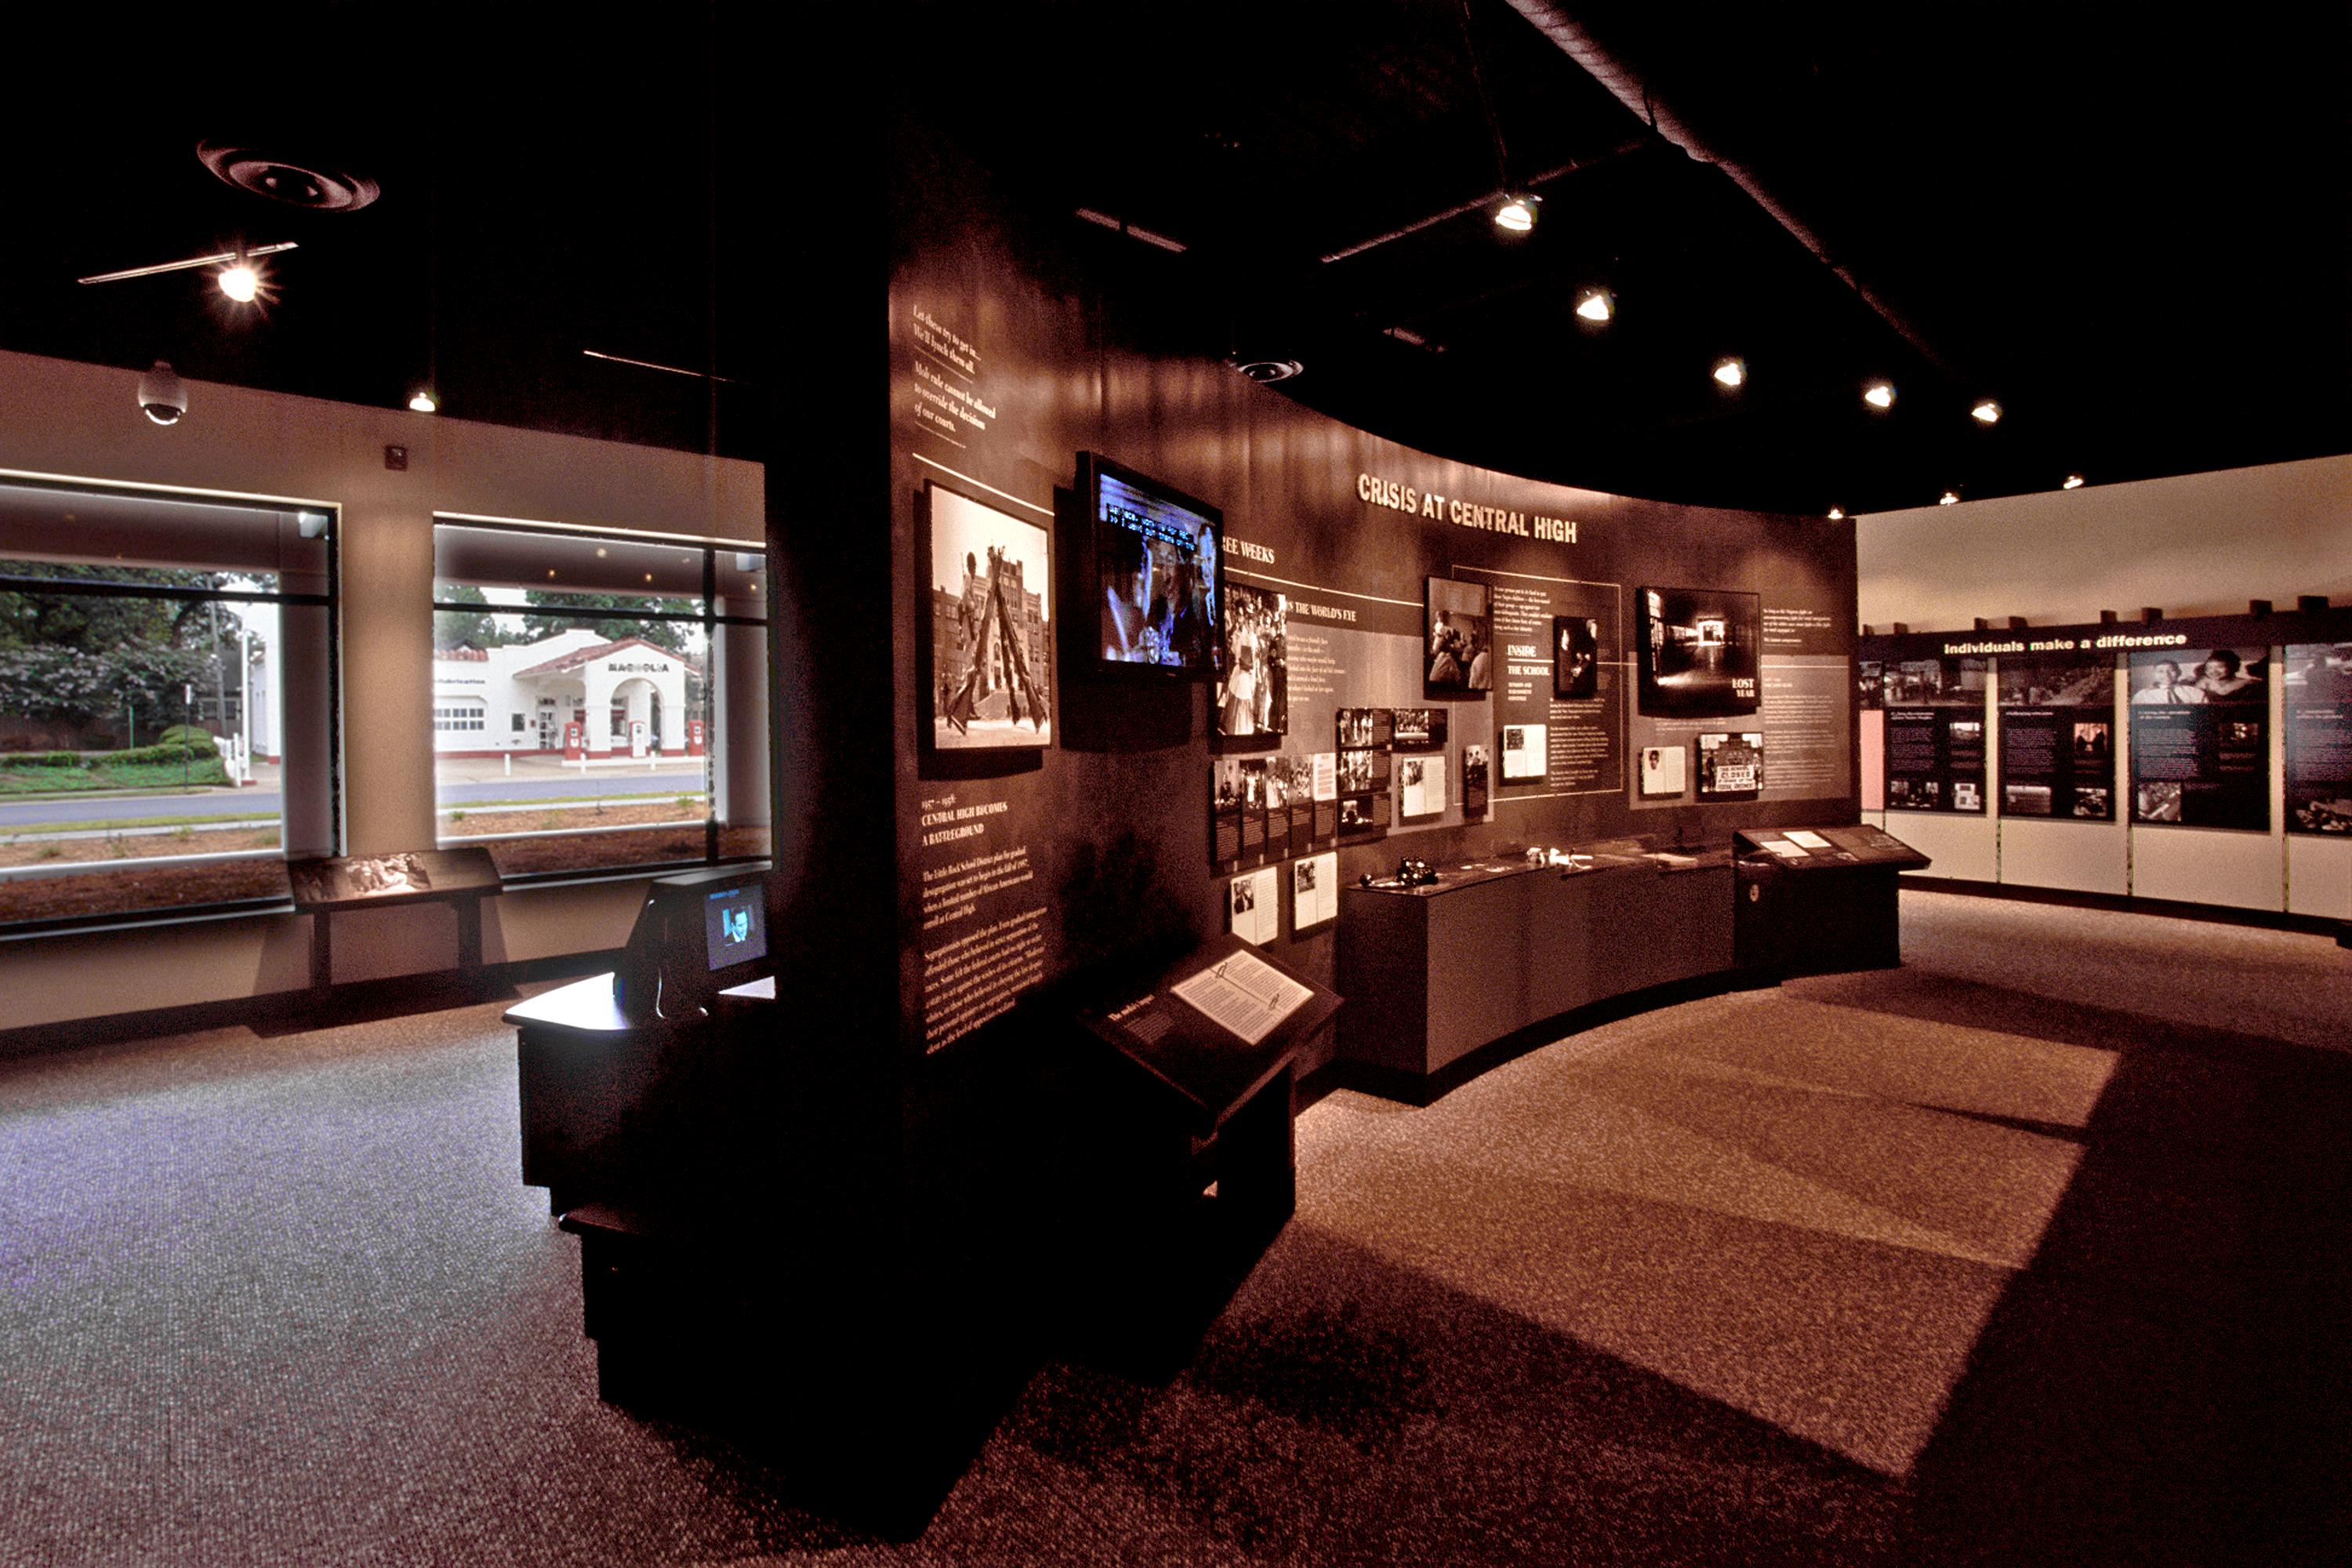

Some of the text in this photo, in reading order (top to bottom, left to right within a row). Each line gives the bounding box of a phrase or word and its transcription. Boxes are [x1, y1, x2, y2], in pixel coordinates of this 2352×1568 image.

[913, 304, 924, 321] Let
[926, 314, 942, 334] them
[942, 328, 951, 343] try
[953, 334, 959, 345] to
[960, 341, 968, 353] get
[913, 323, 931, 344] We'll
[949, 349, 964, 367] them
[915, 361, 930, 379] Mob
[931, 374, 943, 388] rule
[944, 383, 965, 401] cannot
[966, 392, 974, 405] be
[974, 398, 996, 419] allowed
[914, 383, 985, 430] to override the decisions
[915, 401, 923, 416] of
[922, 408, 934, 420] our
[1358, 474, 1577, 543] CRISIS AT CENTRAL HIGH
[1240, 541, 1276, 564] WEEKS
[1295, 601, 1309, 615] THE
[1311, 604, 1342, 620] WORLD'S
[1343, 610, 1356, 622] EYE
[1507, 644, 1537, 658] INSIDE
[1944, 634, 2187, 655] Individuals make a difference
[1507, 666, 1551, 677] THE SCHOOL
[1732, 678, 1755, 688] LOST
[1736, 689, 1755, 698] YEAR
[921, 801, 1007, 826] CENTRAL HIGH BECOMES
[922, 823, 985, 846] A BATTLEGROUND
